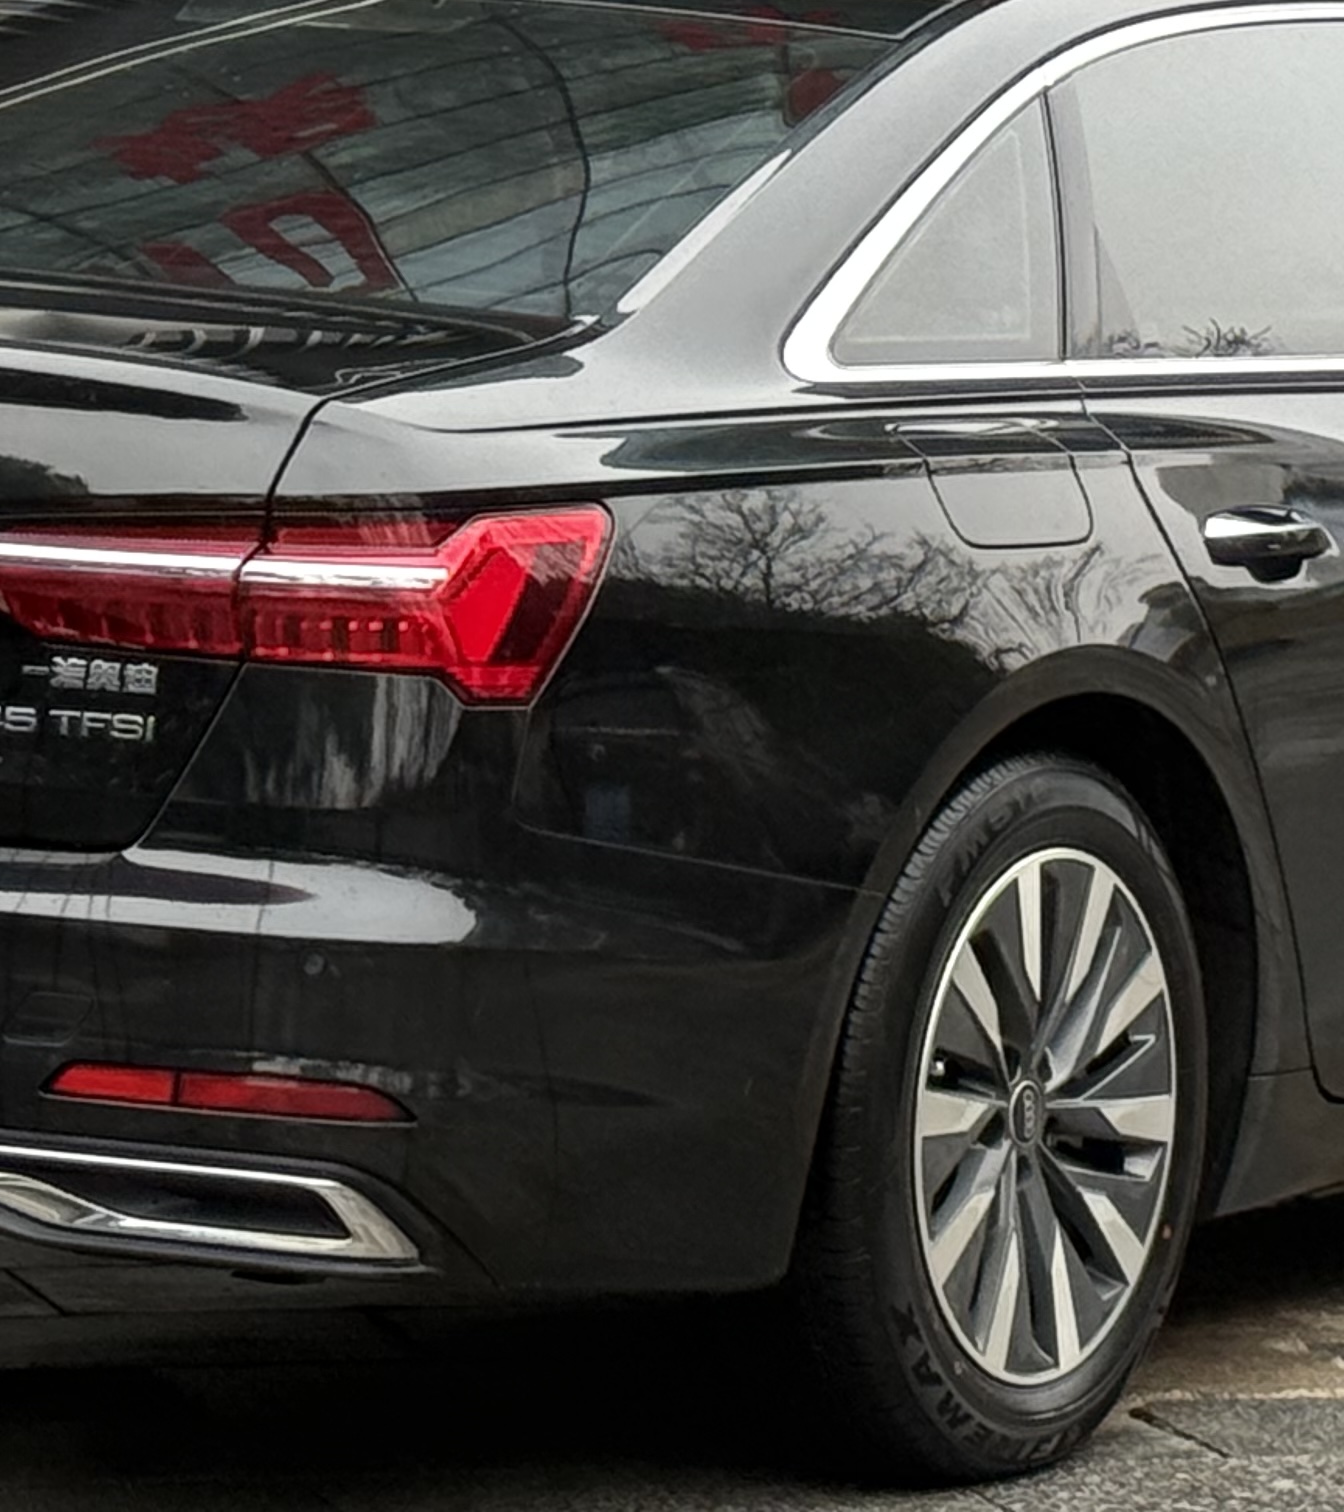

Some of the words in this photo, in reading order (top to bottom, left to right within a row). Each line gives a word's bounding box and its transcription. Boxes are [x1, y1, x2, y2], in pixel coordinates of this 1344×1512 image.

[22, 656, 159, 695] 一汽奥迪
[48, 709, 156, 742] TFSI
